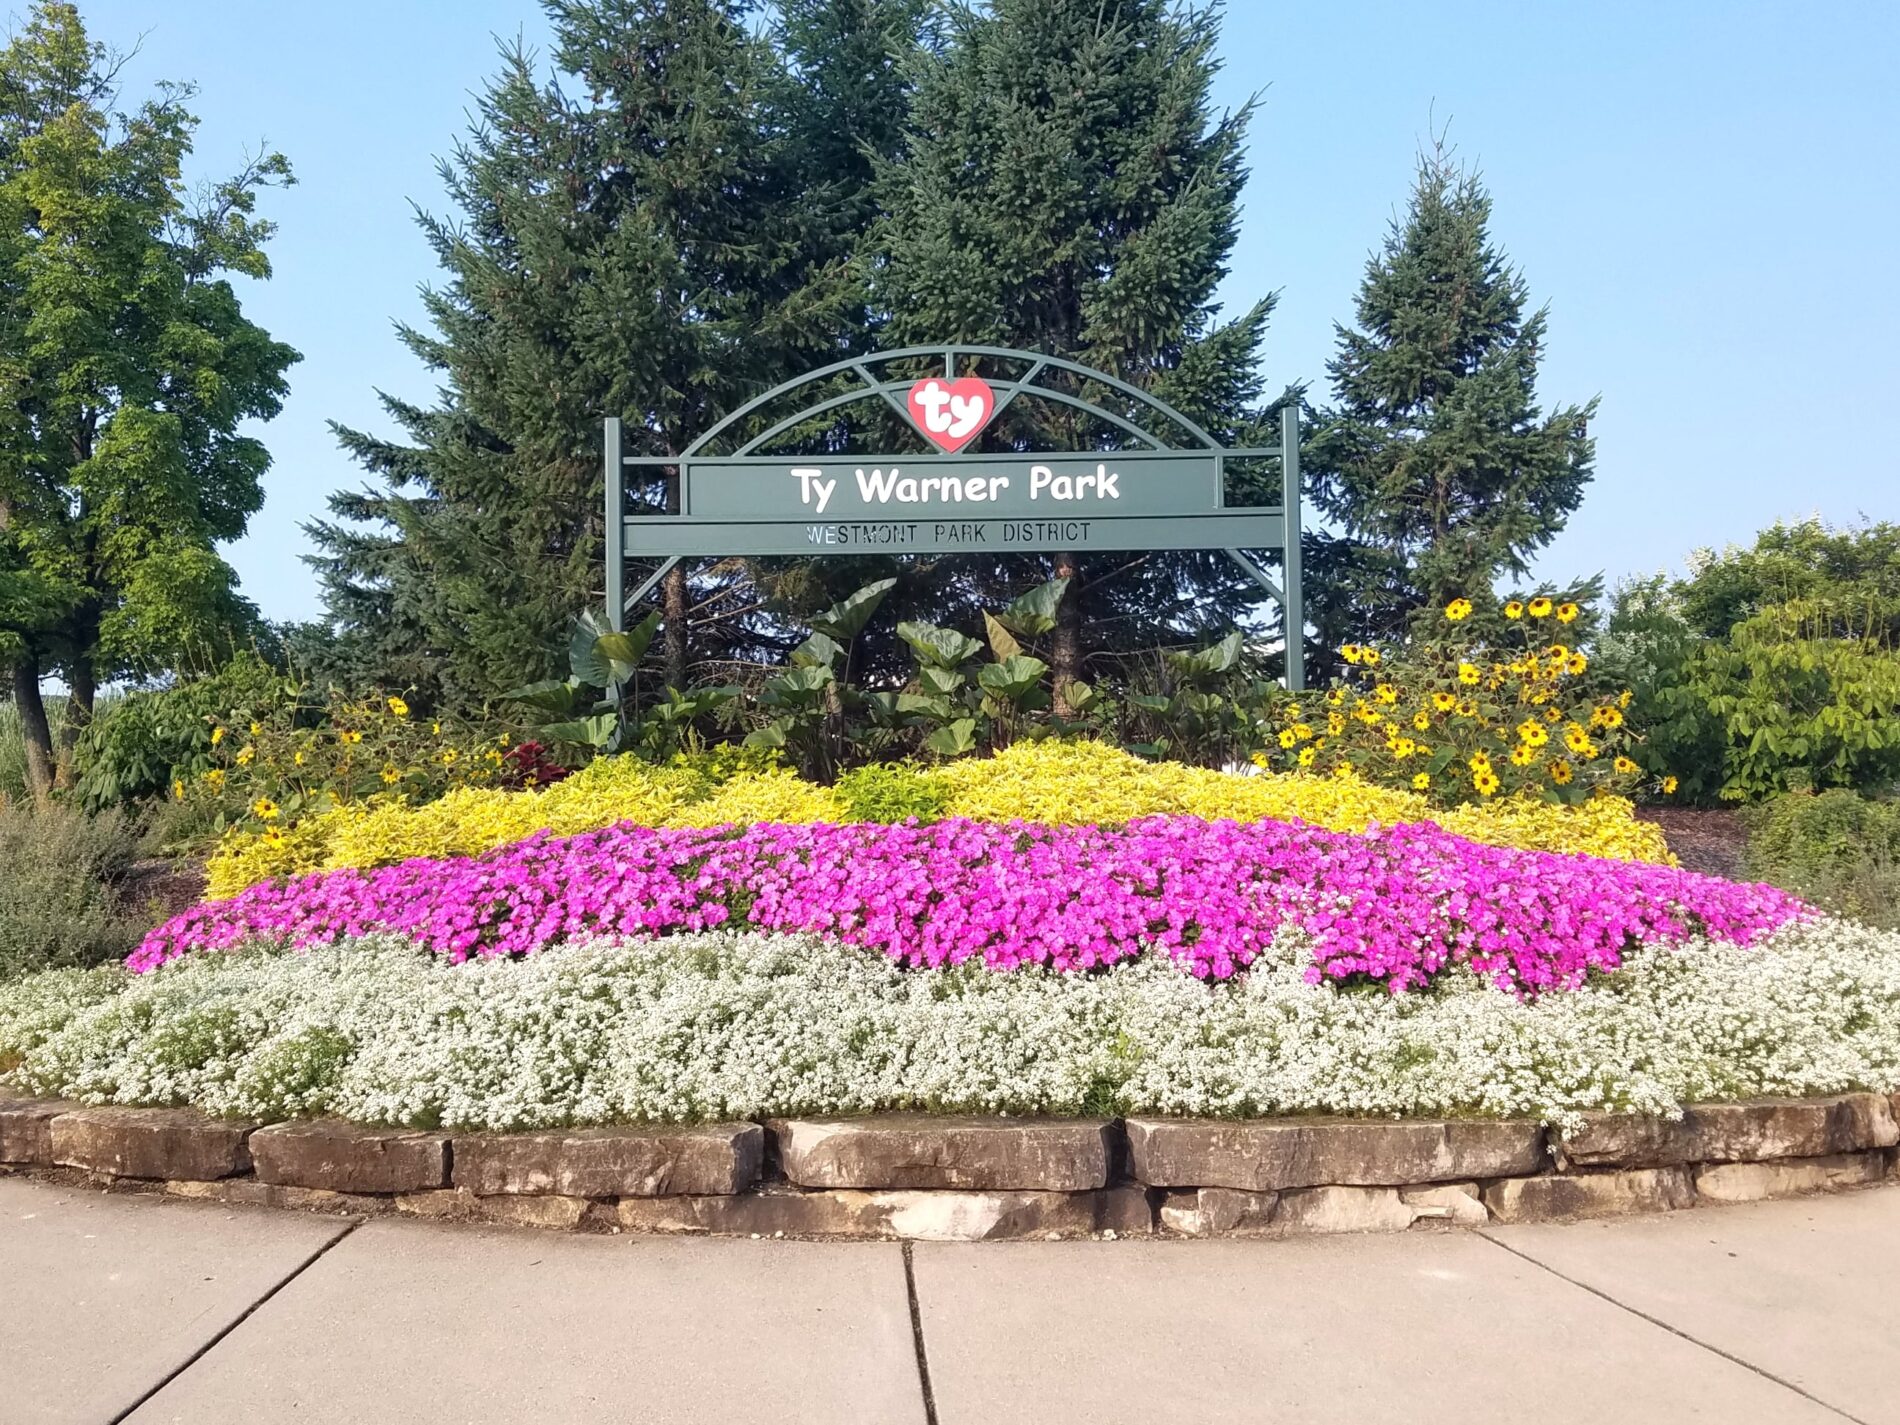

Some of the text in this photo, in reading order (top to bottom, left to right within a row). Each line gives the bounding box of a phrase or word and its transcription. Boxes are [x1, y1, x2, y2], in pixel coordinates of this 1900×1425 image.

[914, 381, 984, 438] ty
[790, 464, 1120, 514] Ty Warner Park
[806, 522, 1091, 545] WESTMONT PARK DISTRICT
